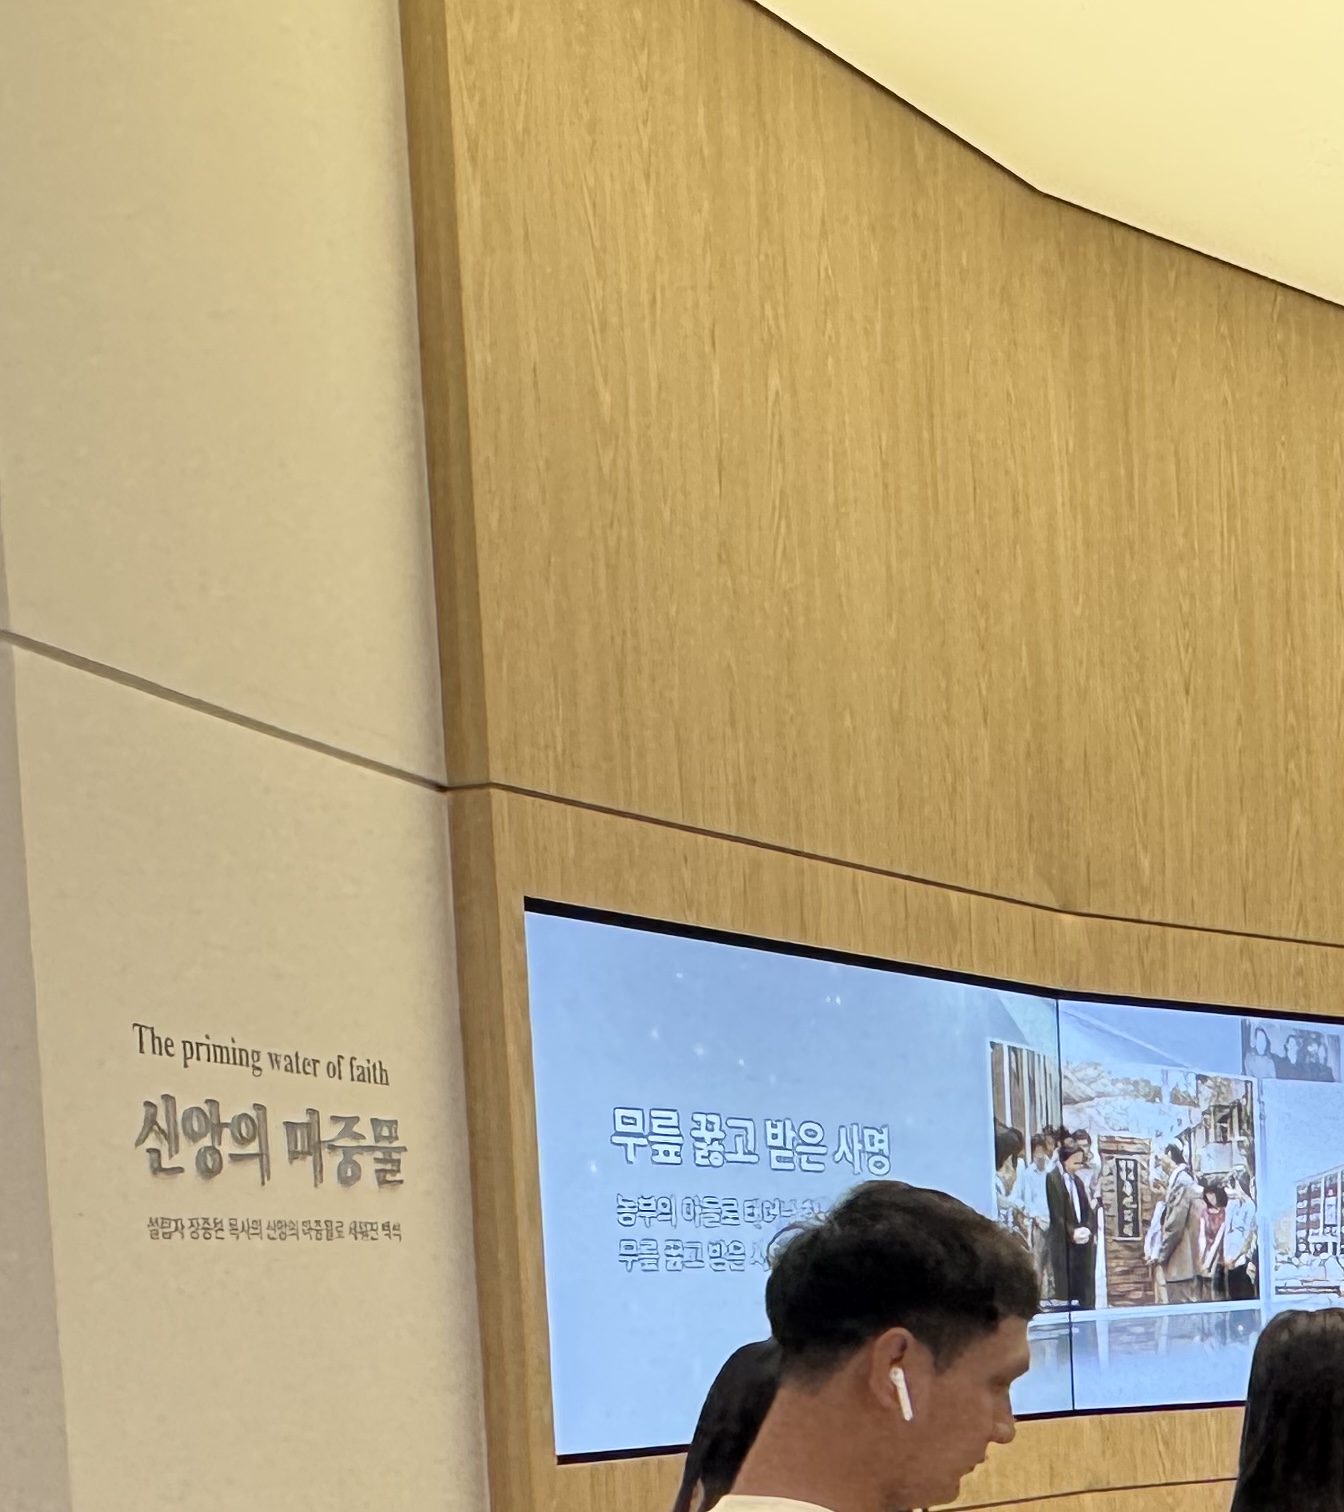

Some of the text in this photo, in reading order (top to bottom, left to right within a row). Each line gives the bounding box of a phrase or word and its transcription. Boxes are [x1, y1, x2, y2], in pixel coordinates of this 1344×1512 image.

[132, 1023, 390, 1087] The priming water of faith
[134, 1093, 408, 1189] 신앙의 마중물
[610, 1107, 892, 1177] 무릎 꿇고 받은 사명
[228, 1217, 263, 1241] 목사의
[616, 1193, 677, 1229] 농부의
[681, 1194, 741, 1229] 아들로
